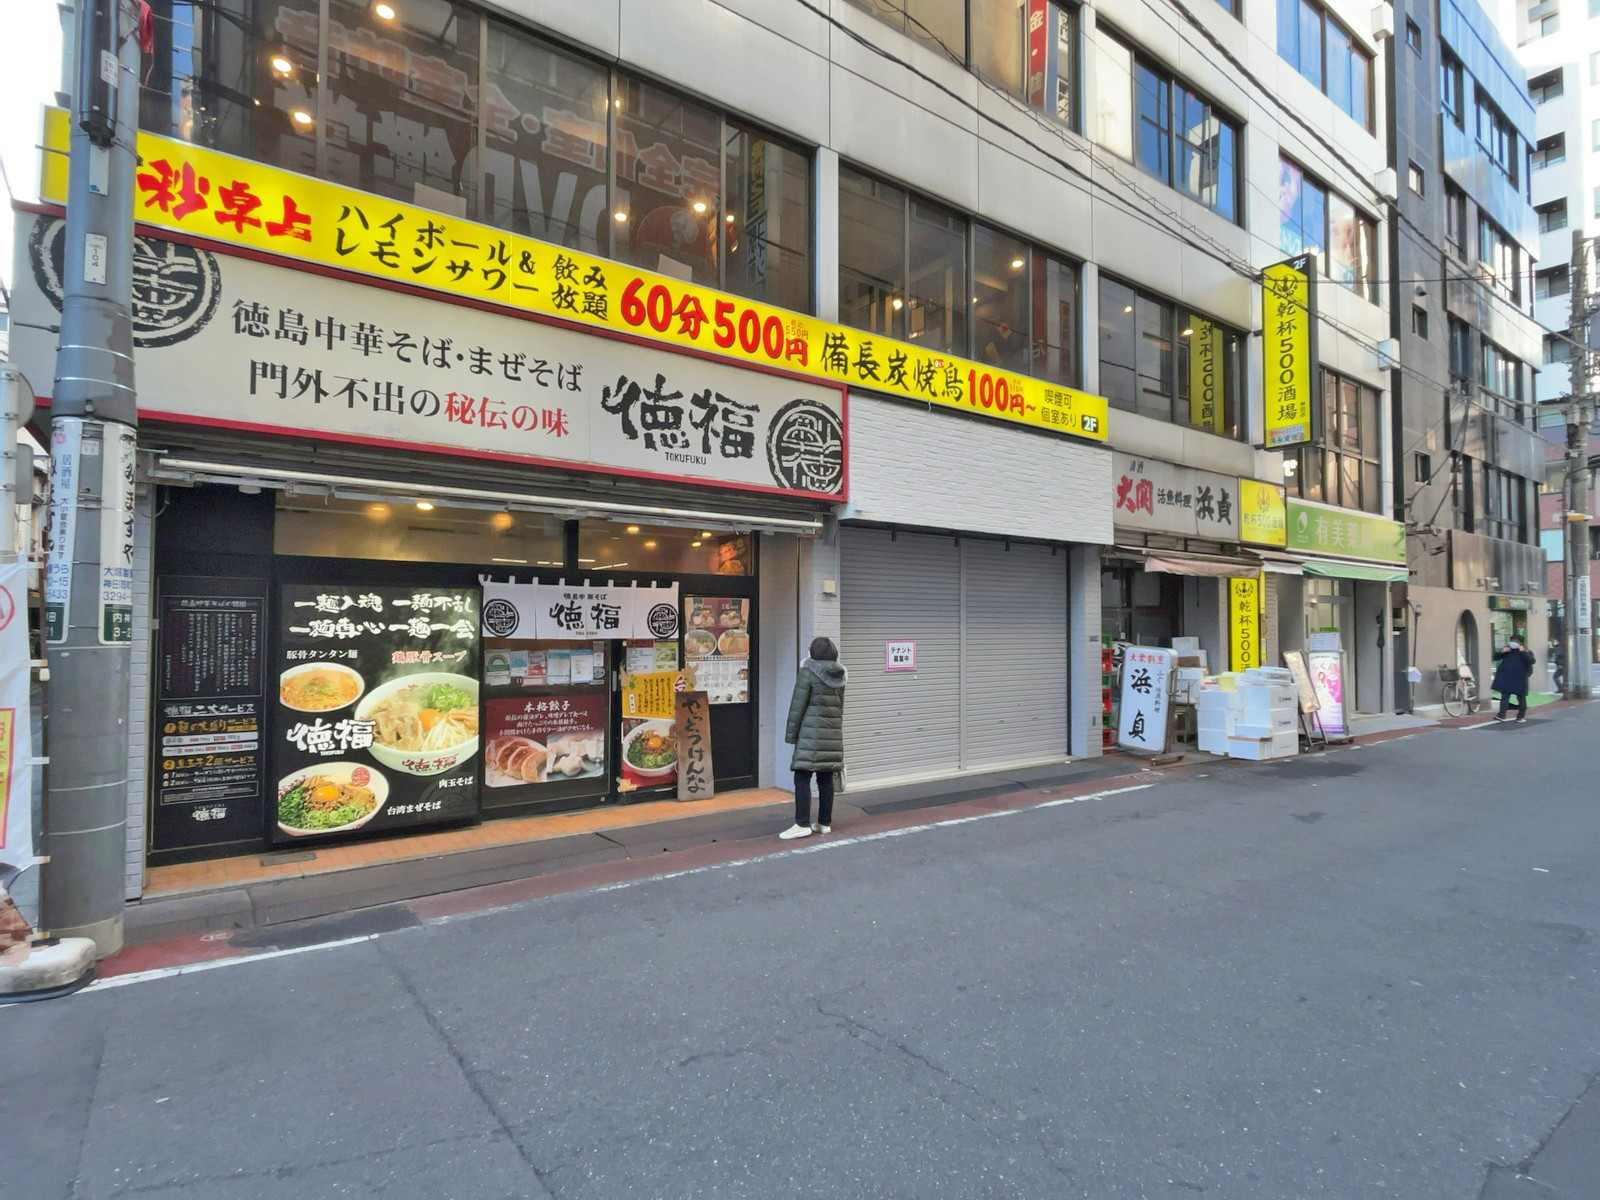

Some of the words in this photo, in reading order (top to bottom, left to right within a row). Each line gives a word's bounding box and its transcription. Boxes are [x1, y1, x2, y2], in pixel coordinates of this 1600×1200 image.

[335, 227, 540, 294] レモンサワー
[551, 253, 608, 290] 飲み
[1293, 257, 1306, 270] 2F
[552, 284, 609, 321] 放題
[231, 299, 583, 393] 徳島中華そば・まぜそば
[785, 326, 809, 341] 550円
[1276, 300, 1297, 421] 乾杯500酒場
[249, 359, 570, 438] 門外不出の秘伝の味
[1044, 389, 1073, 409] 喫煙可
[600, 373, 761, 460] 徳福
[1041, 406, 1077, 428] 個室あり
[1083, 416, 1098, 431] 2F
[664, 451, 707, 466] TOKUFUKU
[61, 454, 72, 489] 居酒屋
[1116, 475, 1154, 517] 大関
[1157, 488, 1193, 510] 活魚料理
[1197, 486, 1232, 526] 浜貞
[549, 601, 622, 630] 徳福
[286, 649, 358, 660] 豚骨タンタン麺
[891, 646, 911, 654] テナント
[524, 700, 571, 713] 本格餃子
[286, 718, 377, 753] 徳福
[439, 776, 474, 789] 肉玉そば
[387, 801, 442, 816] 台湾まぜそば
